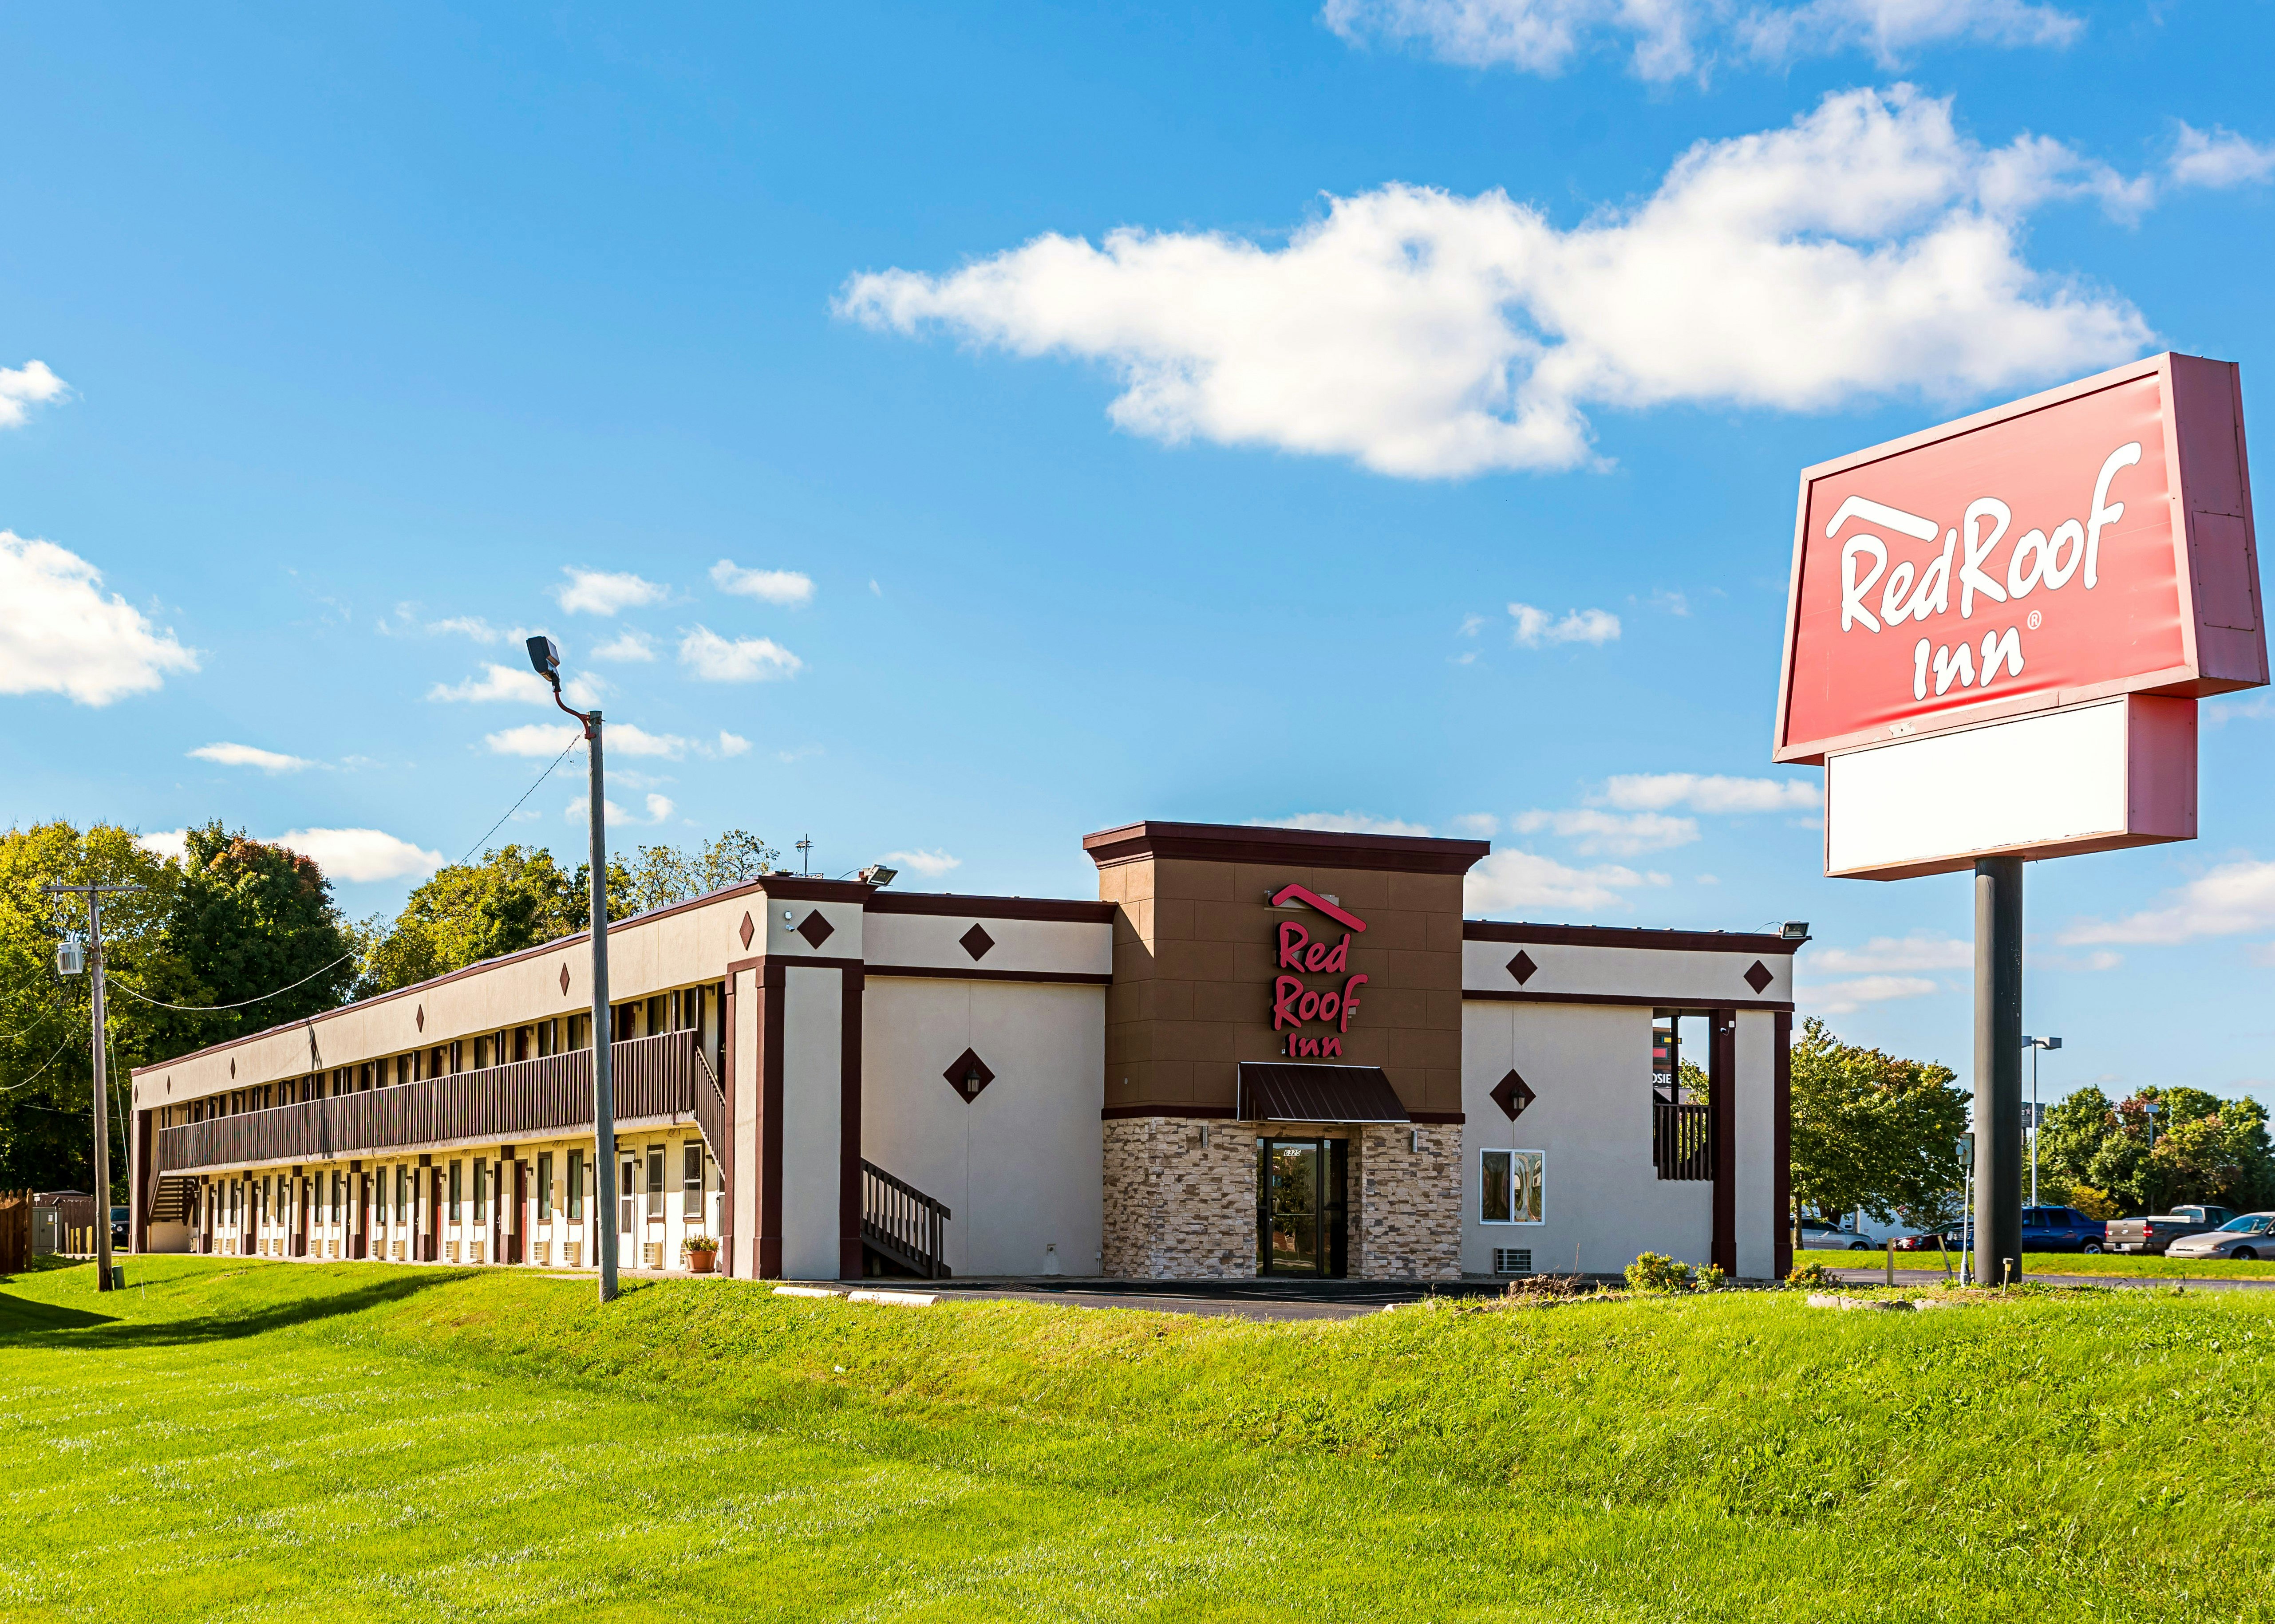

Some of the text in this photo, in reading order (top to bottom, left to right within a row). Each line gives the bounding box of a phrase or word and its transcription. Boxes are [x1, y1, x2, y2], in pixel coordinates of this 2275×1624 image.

[1913, 626, 2025, 701] Inn
[1279, 921, 1351, 973] Red
[1273, 974, 1369, 1033] Roof
[1288, 1033, 1343, 1057] Inn
